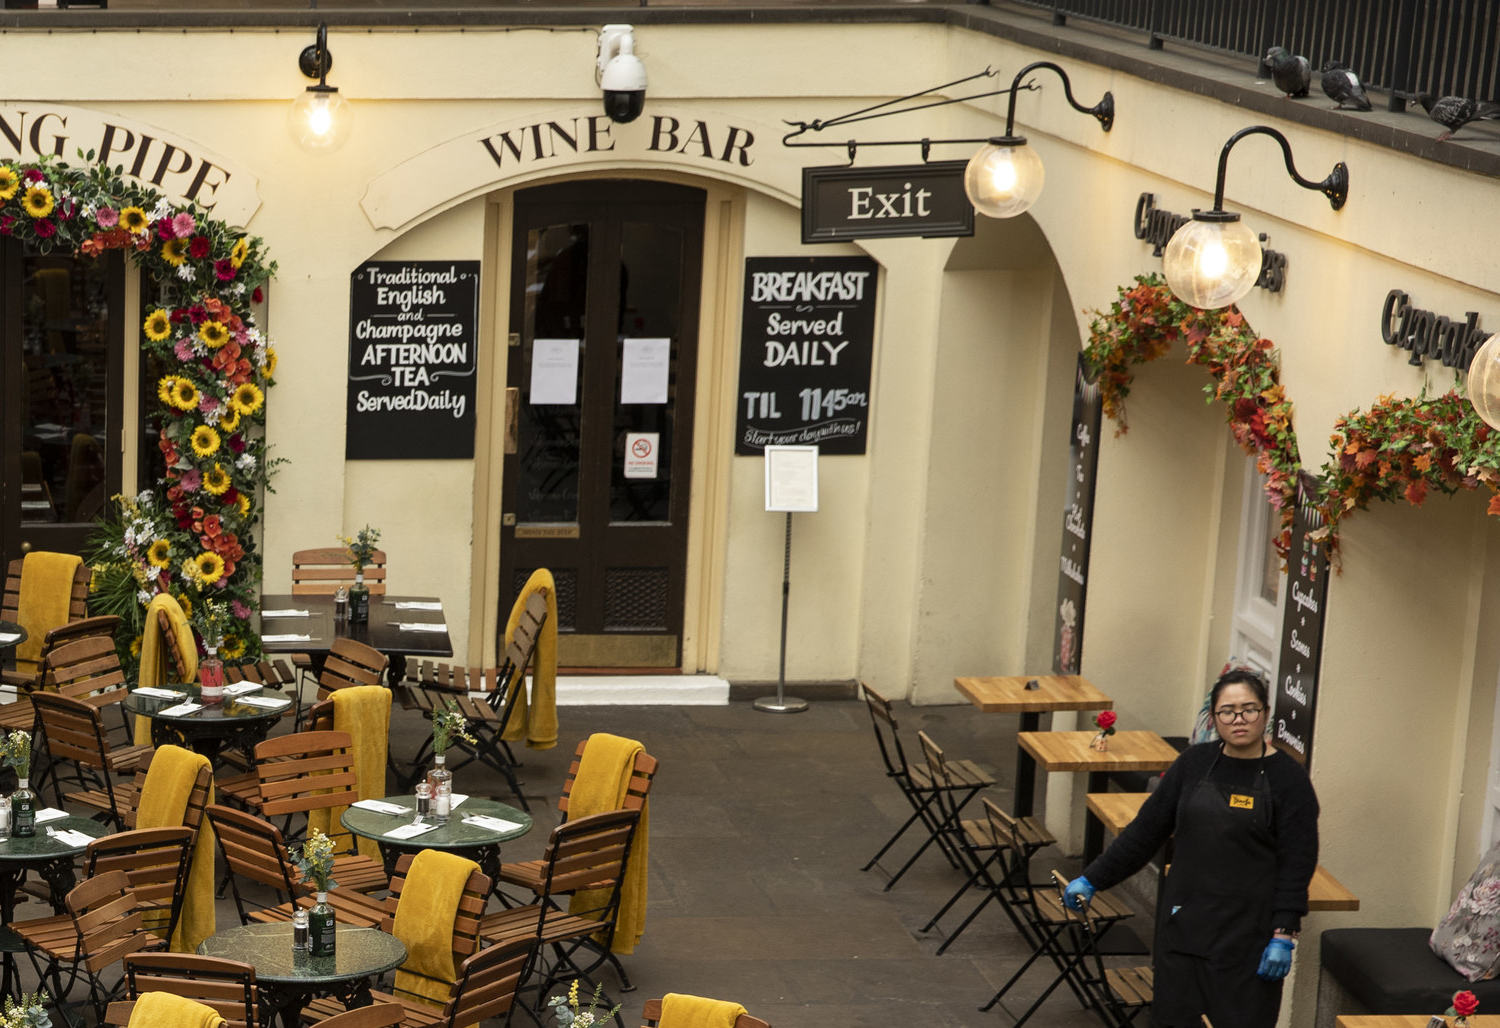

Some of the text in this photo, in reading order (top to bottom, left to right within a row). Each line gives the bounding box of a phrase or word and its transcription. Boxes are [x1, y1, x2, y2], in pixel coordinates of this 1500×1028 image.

[479, 114, 756, 170] WINE BAR
[92, 122, 231, 211] PIPE
[846, 183, 932, 221] Exit
[366, 266, 457, 285] Traditional
[751, 271, 870, 302] BREAKFAST
[376, 285, 446, 312] English
[397, 308, 424, 321] and
[766, 311, 844, 336] Served
[356, 319, 463, 344] Champagne
[361, 342, 467, 365] AFTERNOON
[763, 341, 849, 367] DAILY
[391, 366, 430, 387] TEA
[743, 392, 781, 419] TIL
[744, 429, 773, 445] Start
[1292, 581, 1318, 613] Cupcakes
[1290, 629, 1311, 659] Scones
[1278, 719, 1305, 755] Brownies
